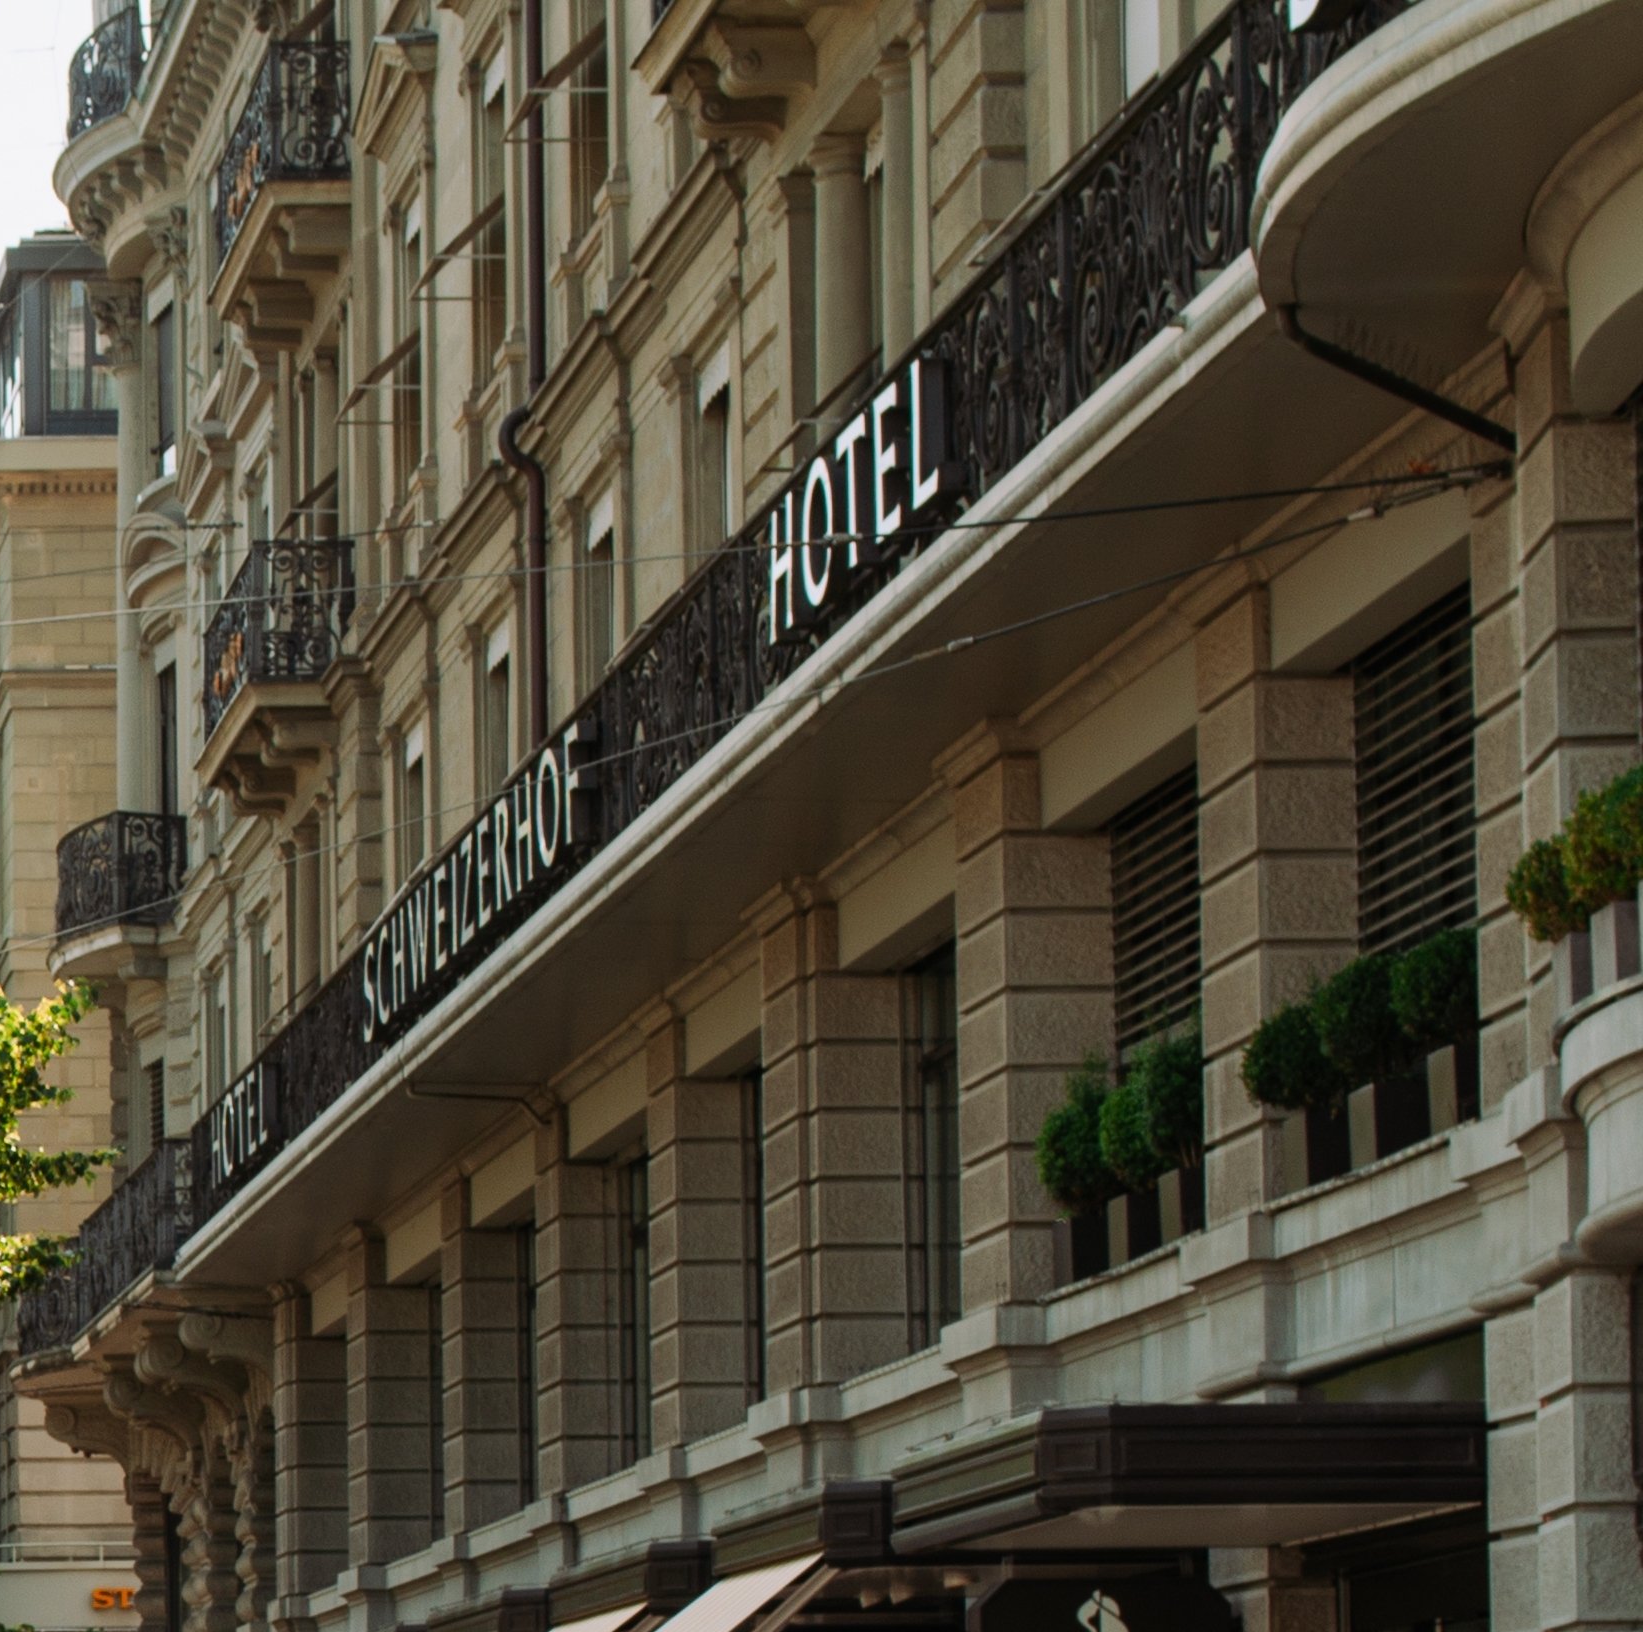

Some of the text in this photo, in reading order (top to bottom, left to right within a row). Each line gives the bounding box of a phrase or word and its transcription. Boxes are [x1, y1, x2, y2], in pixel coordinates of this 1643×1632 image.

[768, 357, 941, 645] HOTEL
[361, 722, 586, 1043] SCHWEIZERHOF
[209, 1069, 269, 1188] HOTEL
